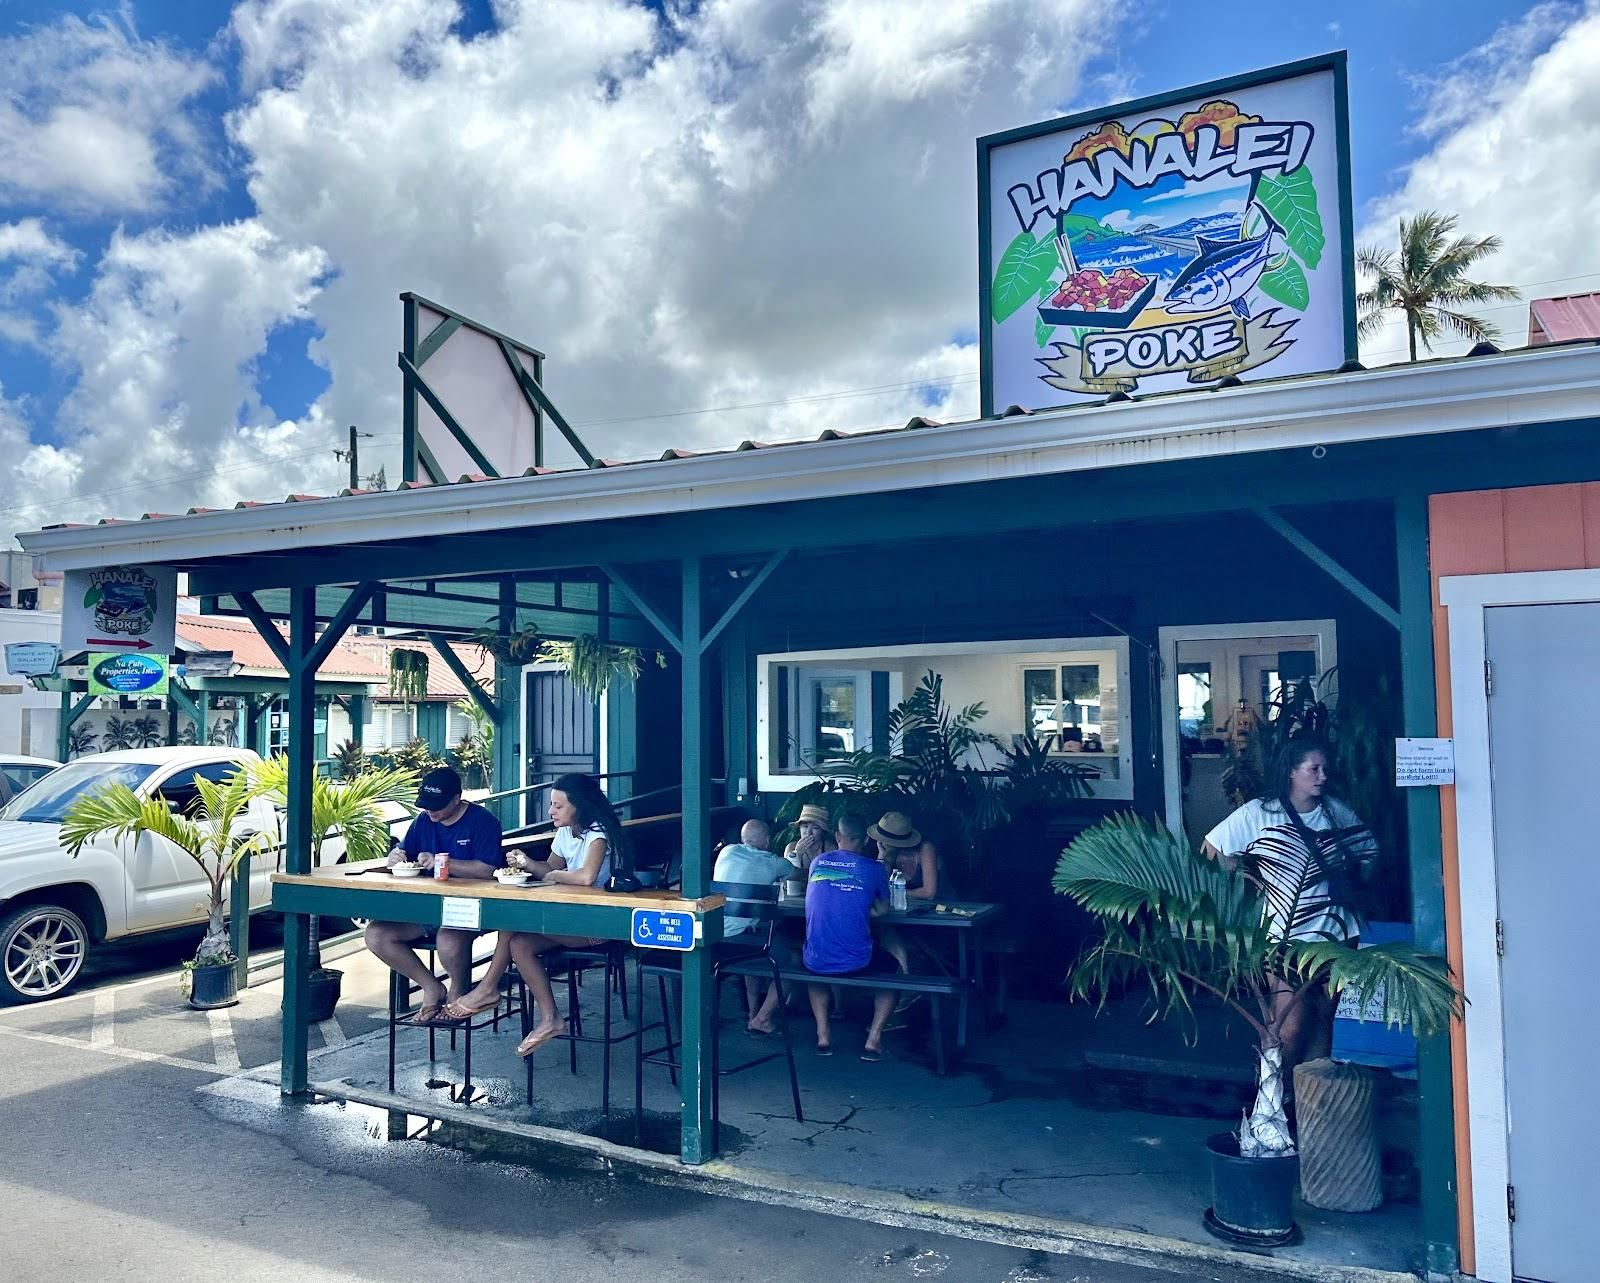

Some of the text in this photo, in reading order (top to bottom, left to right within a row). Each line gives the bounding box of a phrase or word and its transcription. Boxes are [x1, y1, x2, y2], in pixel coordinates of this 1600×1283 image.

[1008, 121, 1314, 233] HANALEI
[1087, 319, 1242, 378] POKE
[89, 571, 159, 591] HANALEI
[107, 619, 140, 630] POKE
[101, 667, 140, 676] Properties,
[657, 934, 682, 942] ASSISTANCE
